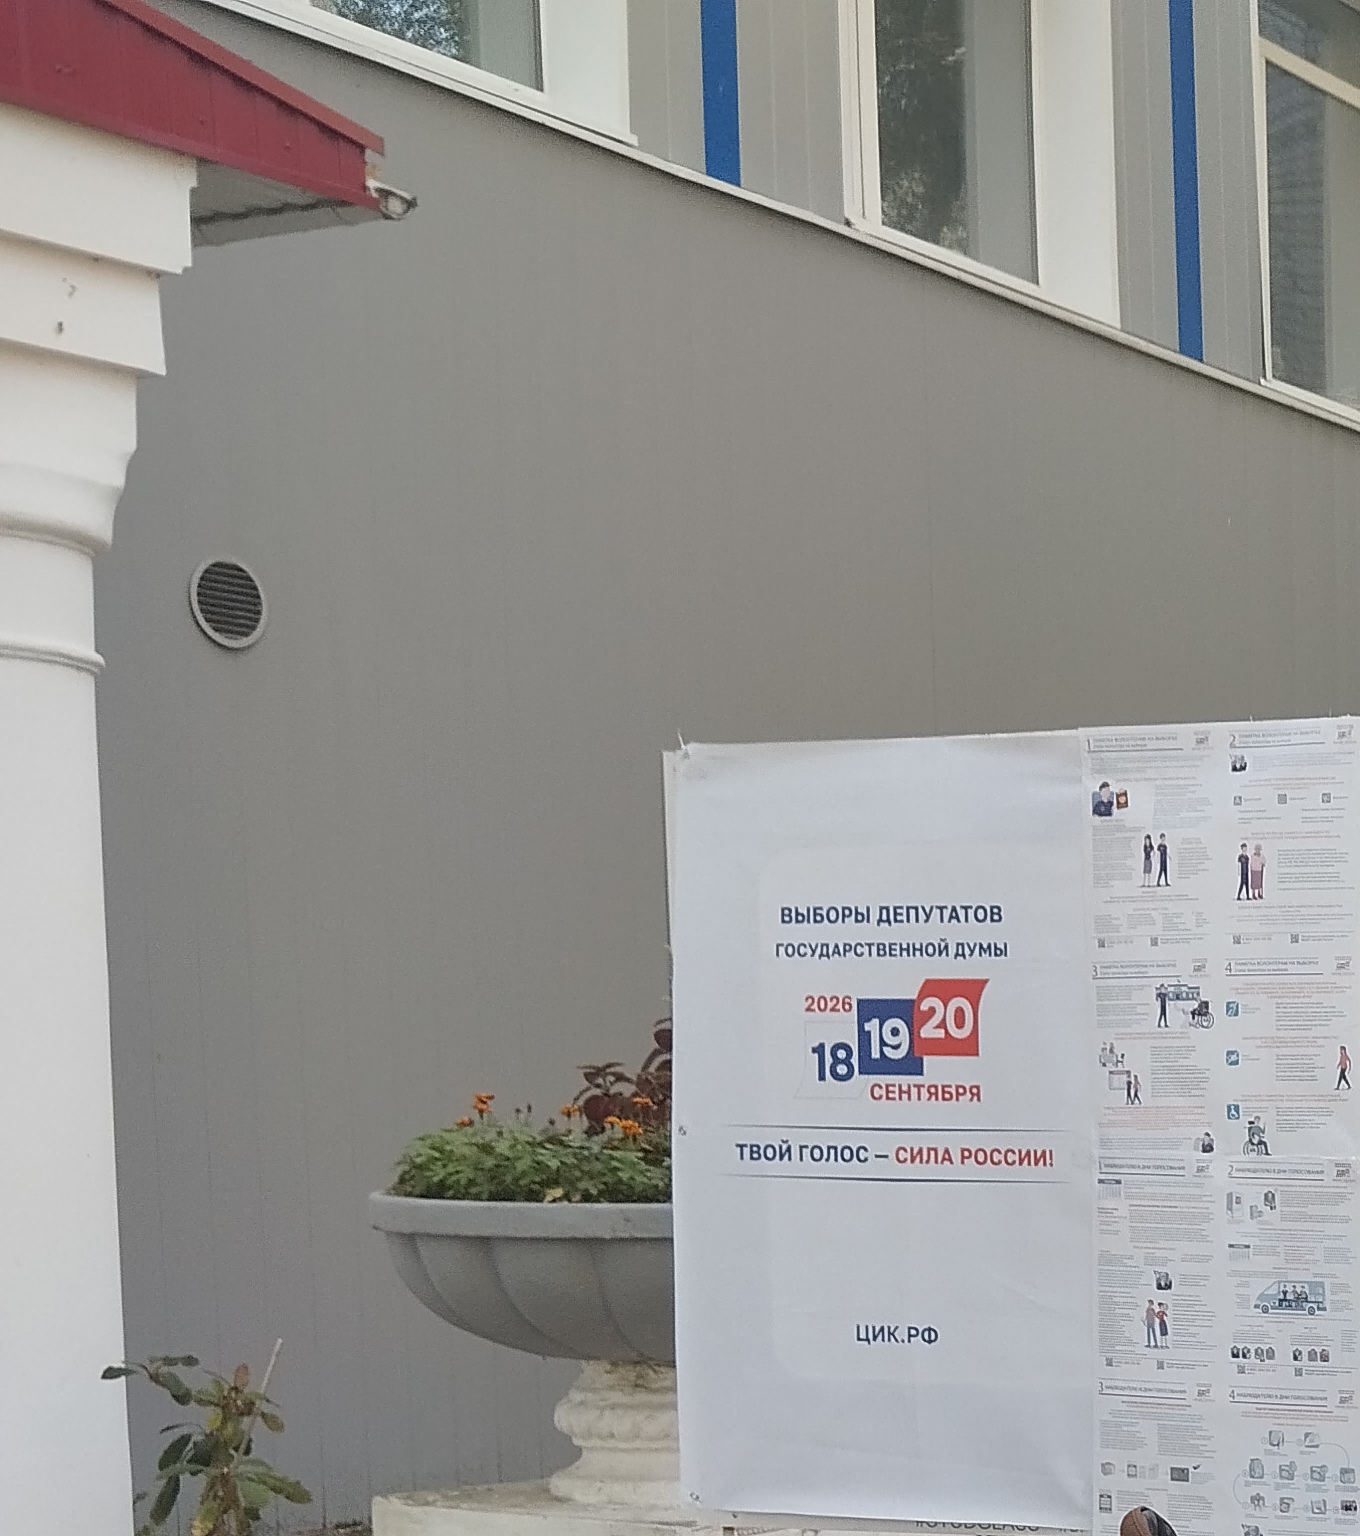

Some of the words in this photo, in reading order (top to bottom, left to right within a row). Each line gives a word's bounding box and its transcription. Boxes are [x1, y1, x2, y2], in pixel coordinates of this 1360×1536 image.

[780, 905, 871, 925] ВЫБОРЫ
[876, 904, 1003, 927] ДЕПУТАТОВ
[775, 938, 950, 959] ГОСУДАРСТВЕННОЙ
[954, 942, 1008, 960] ДУМЫ
[1225, 961, 1232, 973] 4
[804, 995, 854, 1014] 2026
[811, 1041, 855, 1082] 18
[863, 1017, 910, 1060] 19
[919, 996, 976, 1039] 20
[869, 1082, 982, 1103] СЕНТЯБРЯ
[735, 1139, 793, 1163] ТВОЙ
[798, 1144, 870, 1164] ГОЛОС
[894, 1146, 954, 1166] СИЛА
[960, 1147, 1055, 1168] РОССИИ!
[856, 1323, 939, 1345] ЦИК.РФ
[1228, 1389, 1236, 1400] 4
